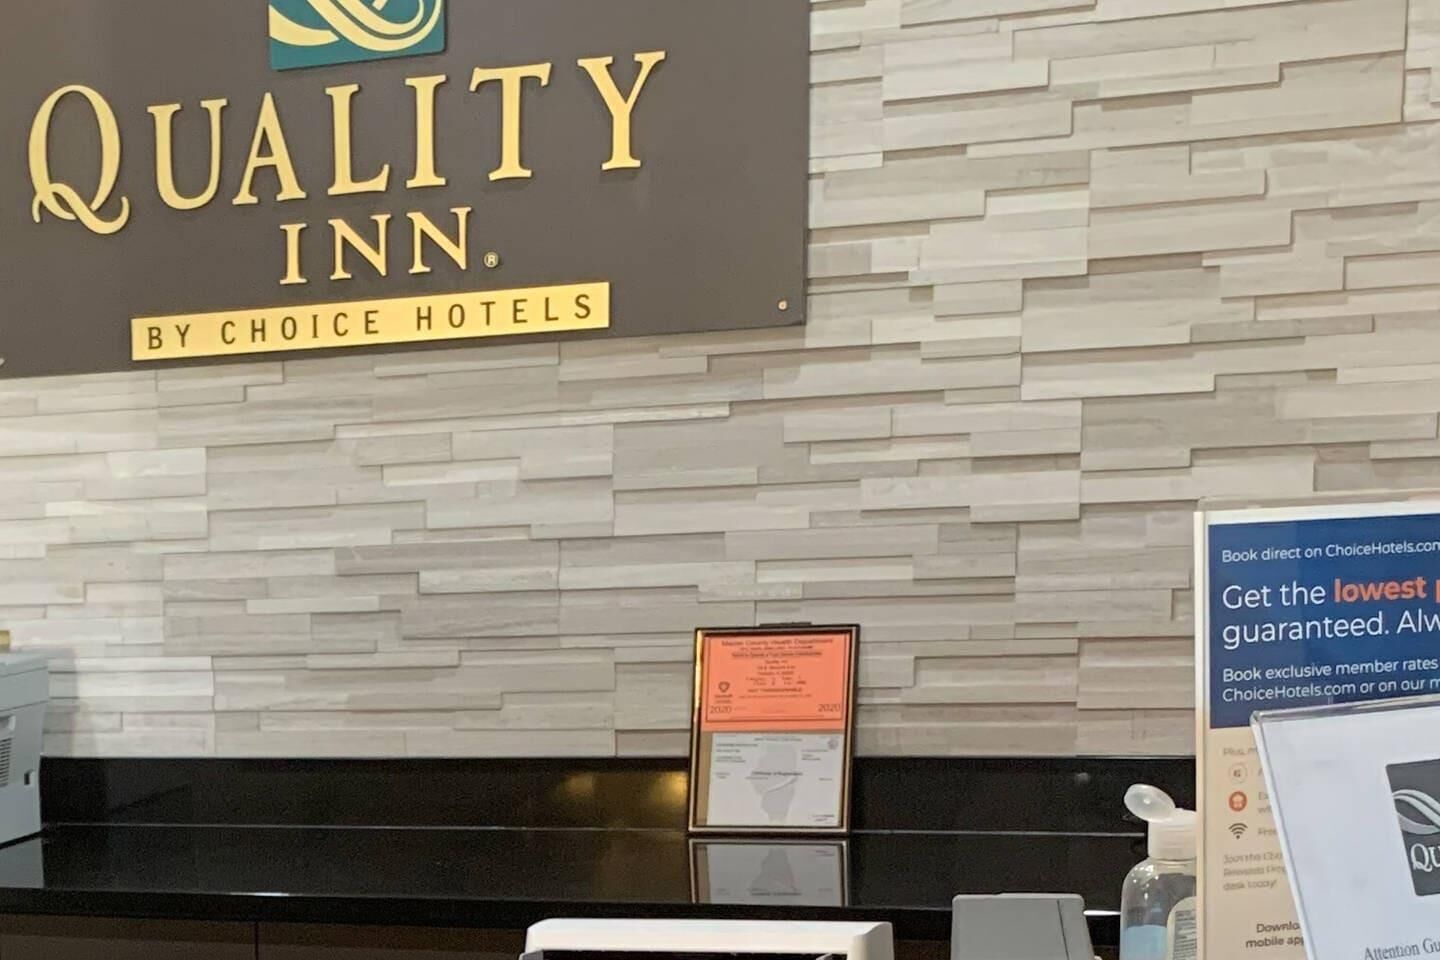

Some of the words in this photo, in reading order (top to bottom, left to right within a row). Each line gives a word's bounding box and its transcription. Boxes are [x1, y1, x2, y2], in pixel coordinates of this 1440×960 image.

[27, 50, 667, 235] QUALITY
[147, 323, 192, 351] BY
[220, 308, 380, 346] CHOICE
[416, 293, 593, 331] HOTELS
[1222, 548, 1258, 563] Book
[1261, 545, 1301, 560] direct
[1304, 547, 1322, 559] on
[1222, 585, 1272, 609] Get
[1279, 581, 1327, 606] the
[1333, 576, 1427, 603] lowest
[1222, 610, 1389, 650] guaranteed.
[1223, 667, 1261, 682] Book
[1265, 661, 1332, 679] exclusive
[1335, 658, 1399, 675] member
[1402, 658, 1439, 671] rates
[1222, 682, 1357, 702] ChoiceHotels.com
[1360, 683, 1375, 694] or
[1378, 680, 1397, 692] on
[1401, 679, 1426, 691] our
[818, 703, 841, 712] 2020
[1245, 936, 1285, 948] mobile
[1287, 936, 1304, 946] ap
